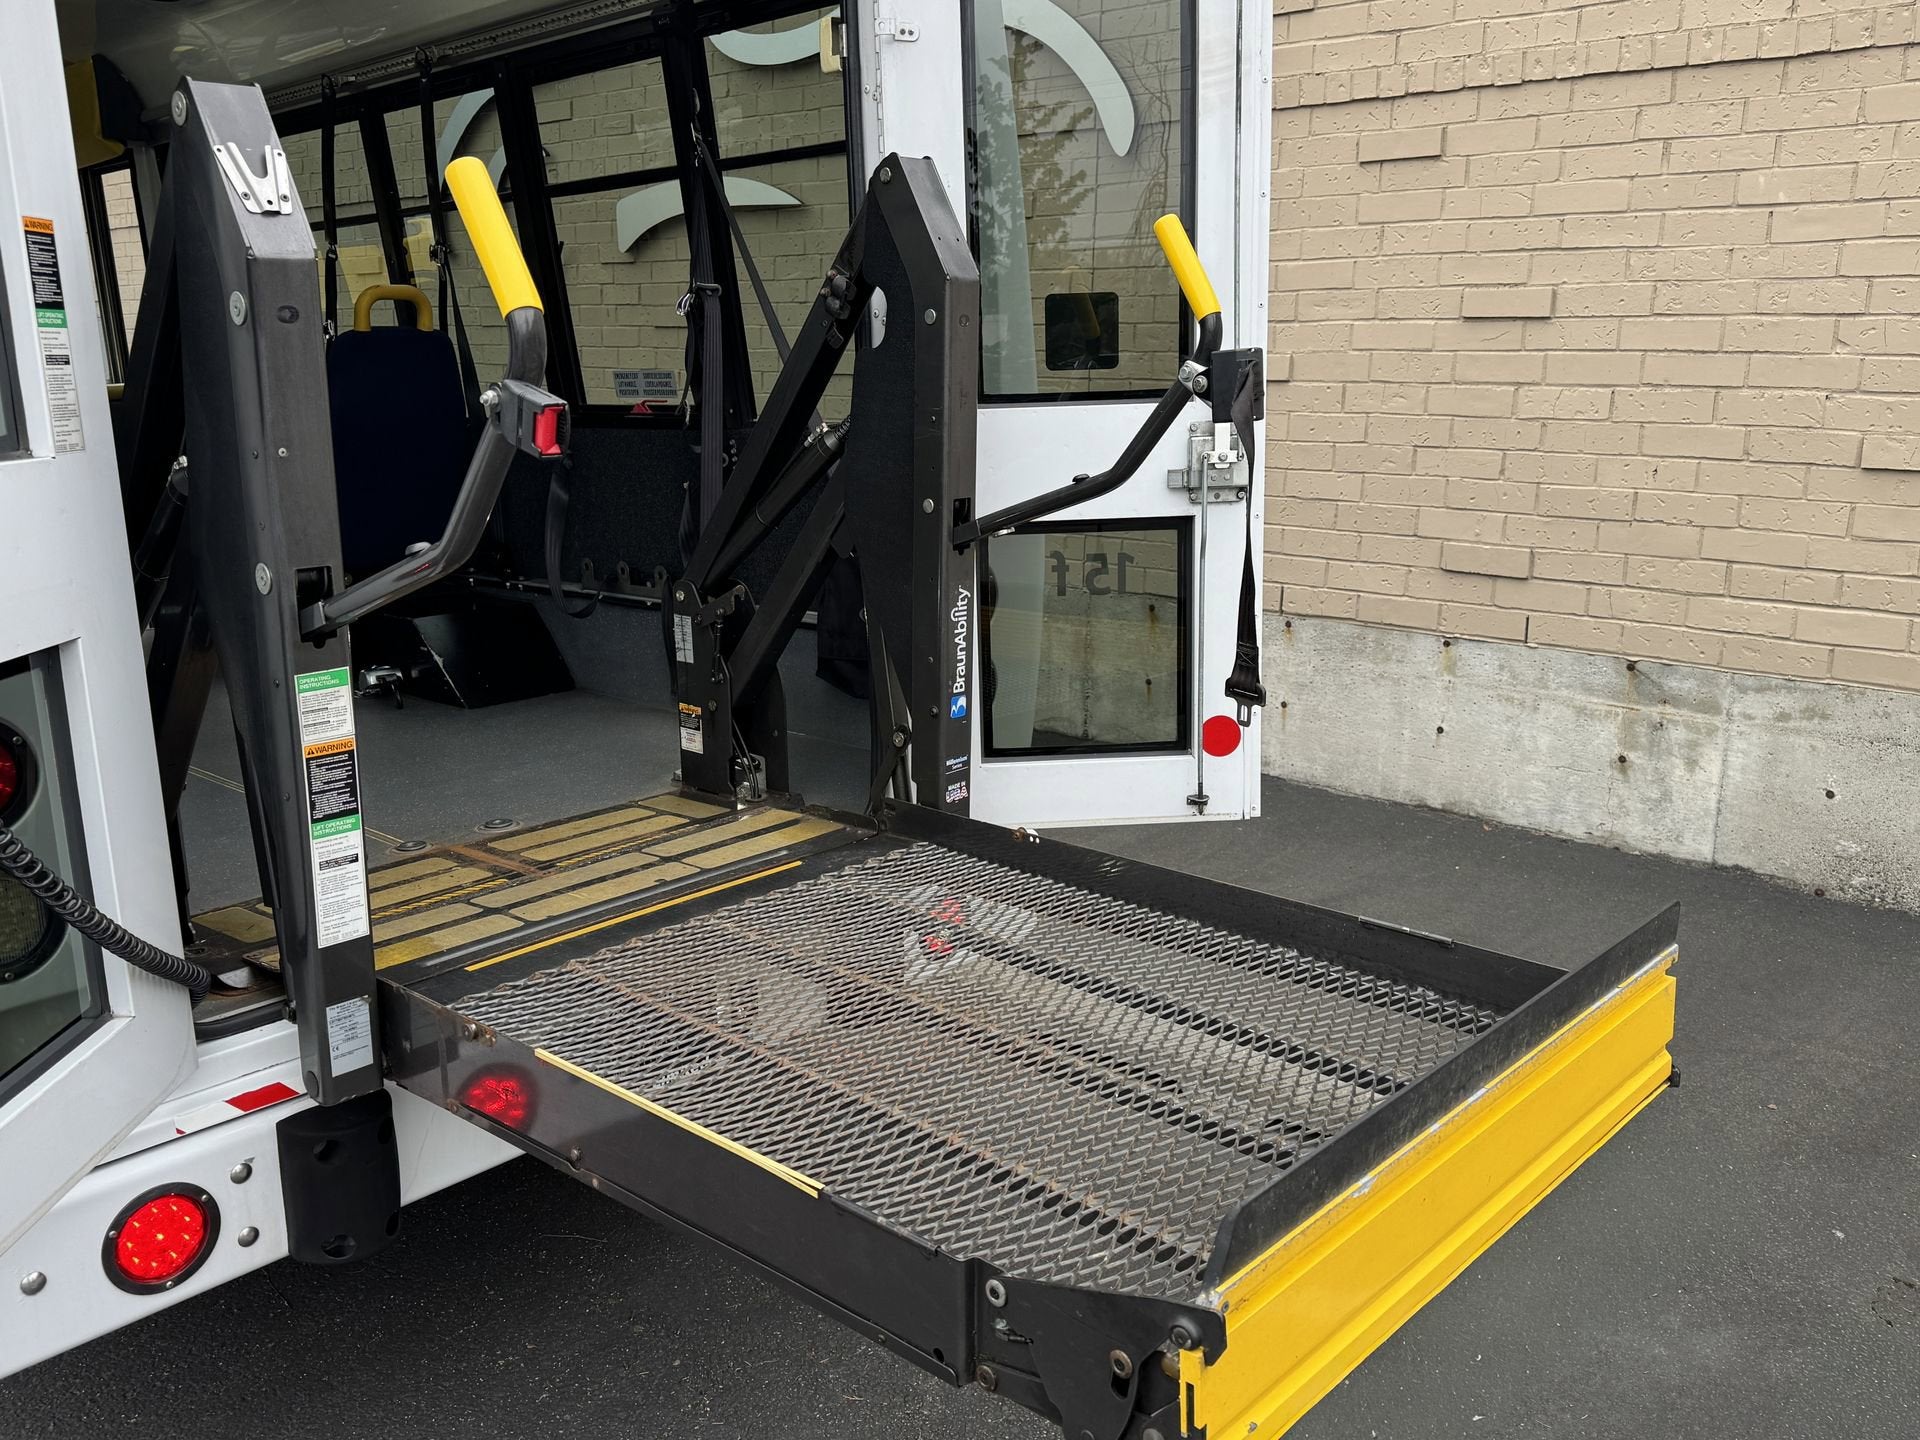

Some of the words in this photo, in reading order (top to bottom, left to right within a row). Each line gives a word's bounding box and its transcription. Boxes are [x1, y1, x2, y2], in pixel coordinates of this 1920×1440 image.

[28, 220, 53, 232] WARNING
[950, 586, 971, 694] BraunAbility
[298, 675, 331, 684] OPERATING
[299, 679, 340, 689] INSTRUCTIONS
[314, 740, 353, 754] WARNING
[945, 786, 968, 803] USA
[312, 824, 325, 832] LIFT
[325, 817, 356, 829] OPERATING
[313, 824, 353, 836] INSTRUCTIONS
